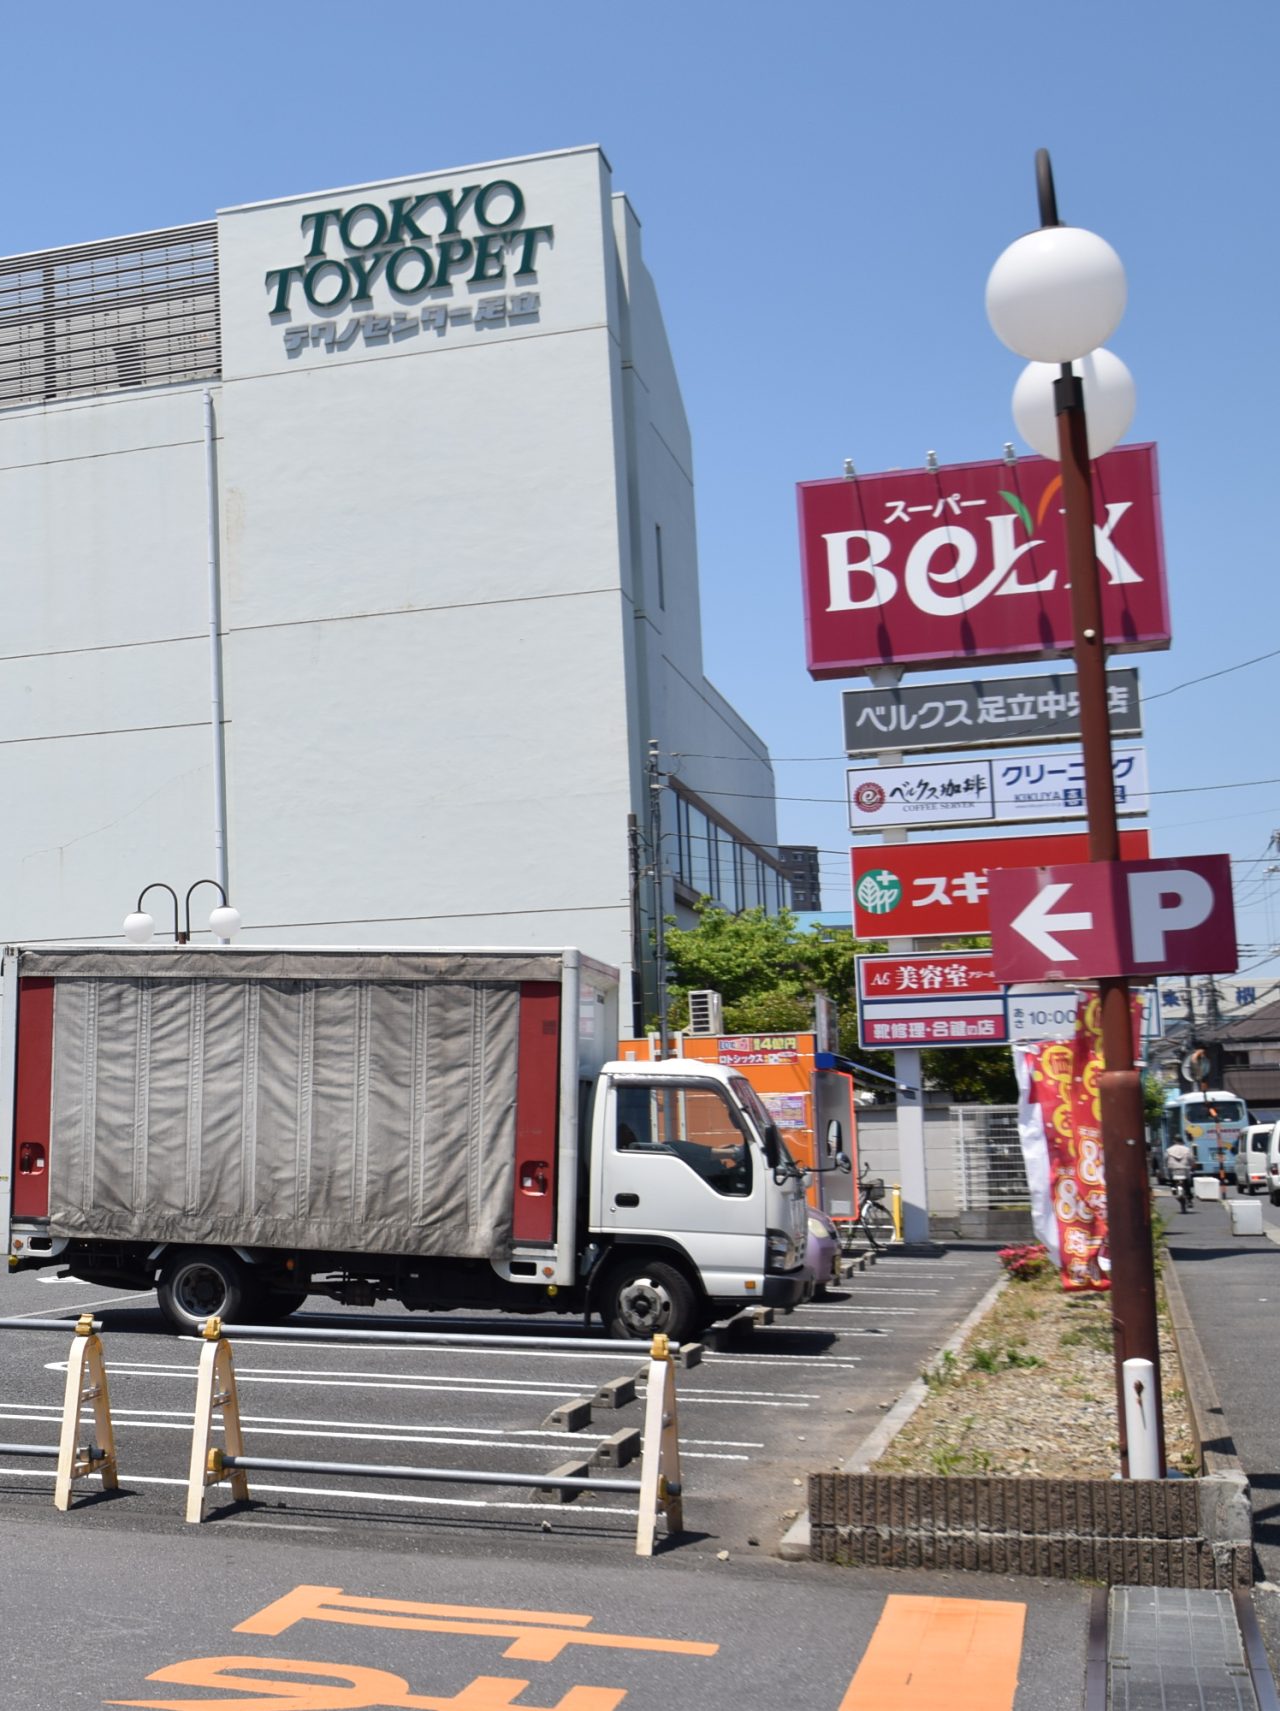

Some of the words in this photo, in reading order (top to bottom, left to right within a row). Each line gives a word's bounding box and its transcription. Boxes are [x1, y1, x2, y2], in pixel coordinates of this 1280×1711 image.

[301, 179, 526, 259] TOKYO
[265, 224, 554, 316] TOYOPET
[284, 292, 541, 351] テクノセンター足立
[883, 493, 987, 525] スーパー
[1002, 756, 1135, 787] クリーニグ
[1126, 869, 1215, 963] P
[896, 964, 968, 990] 美容室
[1029, 1010, 1077, 1025] 10:00
